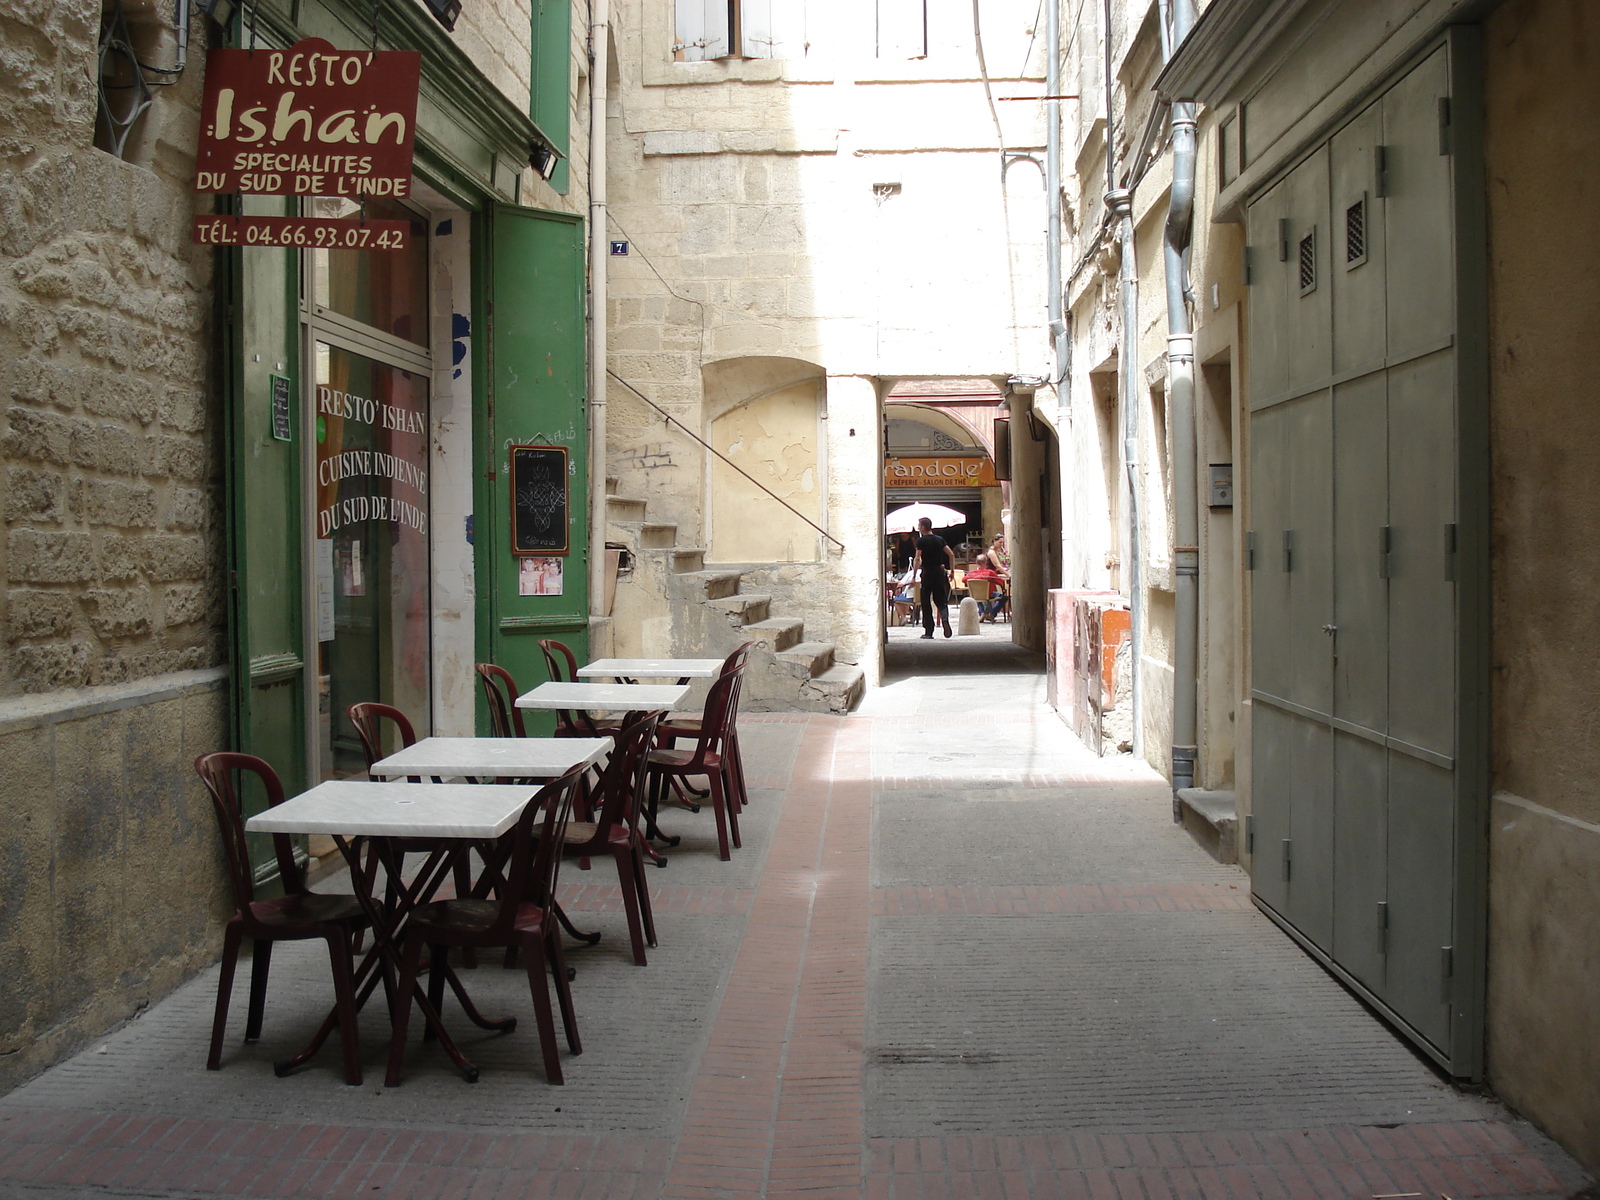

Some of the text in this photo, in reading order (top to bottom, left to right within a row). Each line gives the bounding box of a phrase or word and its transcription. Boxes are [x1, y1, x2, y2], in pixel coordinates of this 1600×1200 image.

[267, 52, 373, 86] RESTO'
[214, 88, 406, 144] Ishan
[233, 152, 372, 174] SPECIALITES
[196, 172, 407, 197] DU SUD DE L'INDE
[198, 220, 404, 249] TÉL: 04.66.93.07.42
[616, 243, 623, 252] 7
[320, 386, 379, 424] RESTO'
[382, 404, 425, 435] ISHAN
[319, 451, 426, 494] CUISINE INDIENNE
[320, 495, 426, 537] DU SUD DE L'INDE
